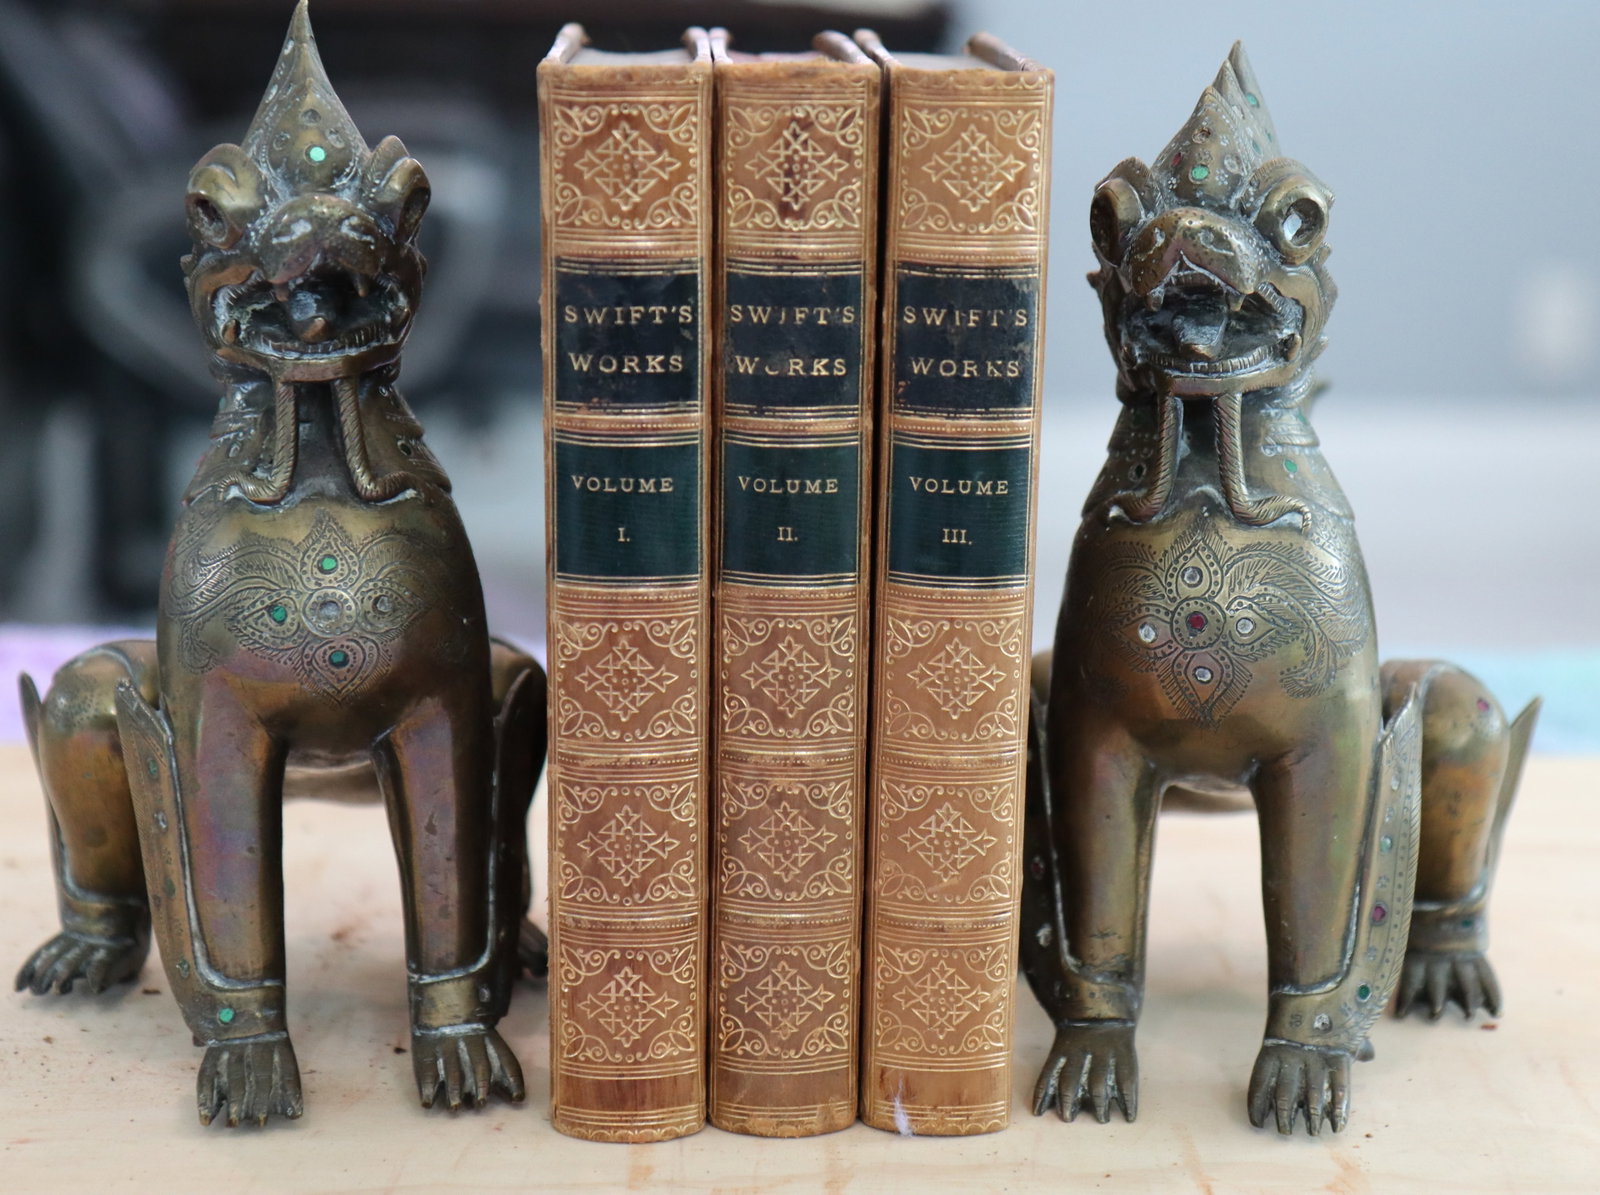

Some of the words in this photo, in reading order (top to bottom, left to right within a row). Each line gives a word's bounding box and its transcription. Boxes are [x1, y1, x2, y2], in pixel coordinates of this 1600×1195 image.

[564, 305, 693, 324] SWIFT'S
[568, 352, 684, 373] WORKS
[911, 357, 1020, 377] WORKS
[571, 475, 674, 493] VOLUME
[738, 476, 838, 494] VOLUME
[909, 476, 1009, 495] VOLUME
[617, 527, 631, 542] I.
[777, 526, 798, 542] II.
[942, 528, 973, 545] III.
